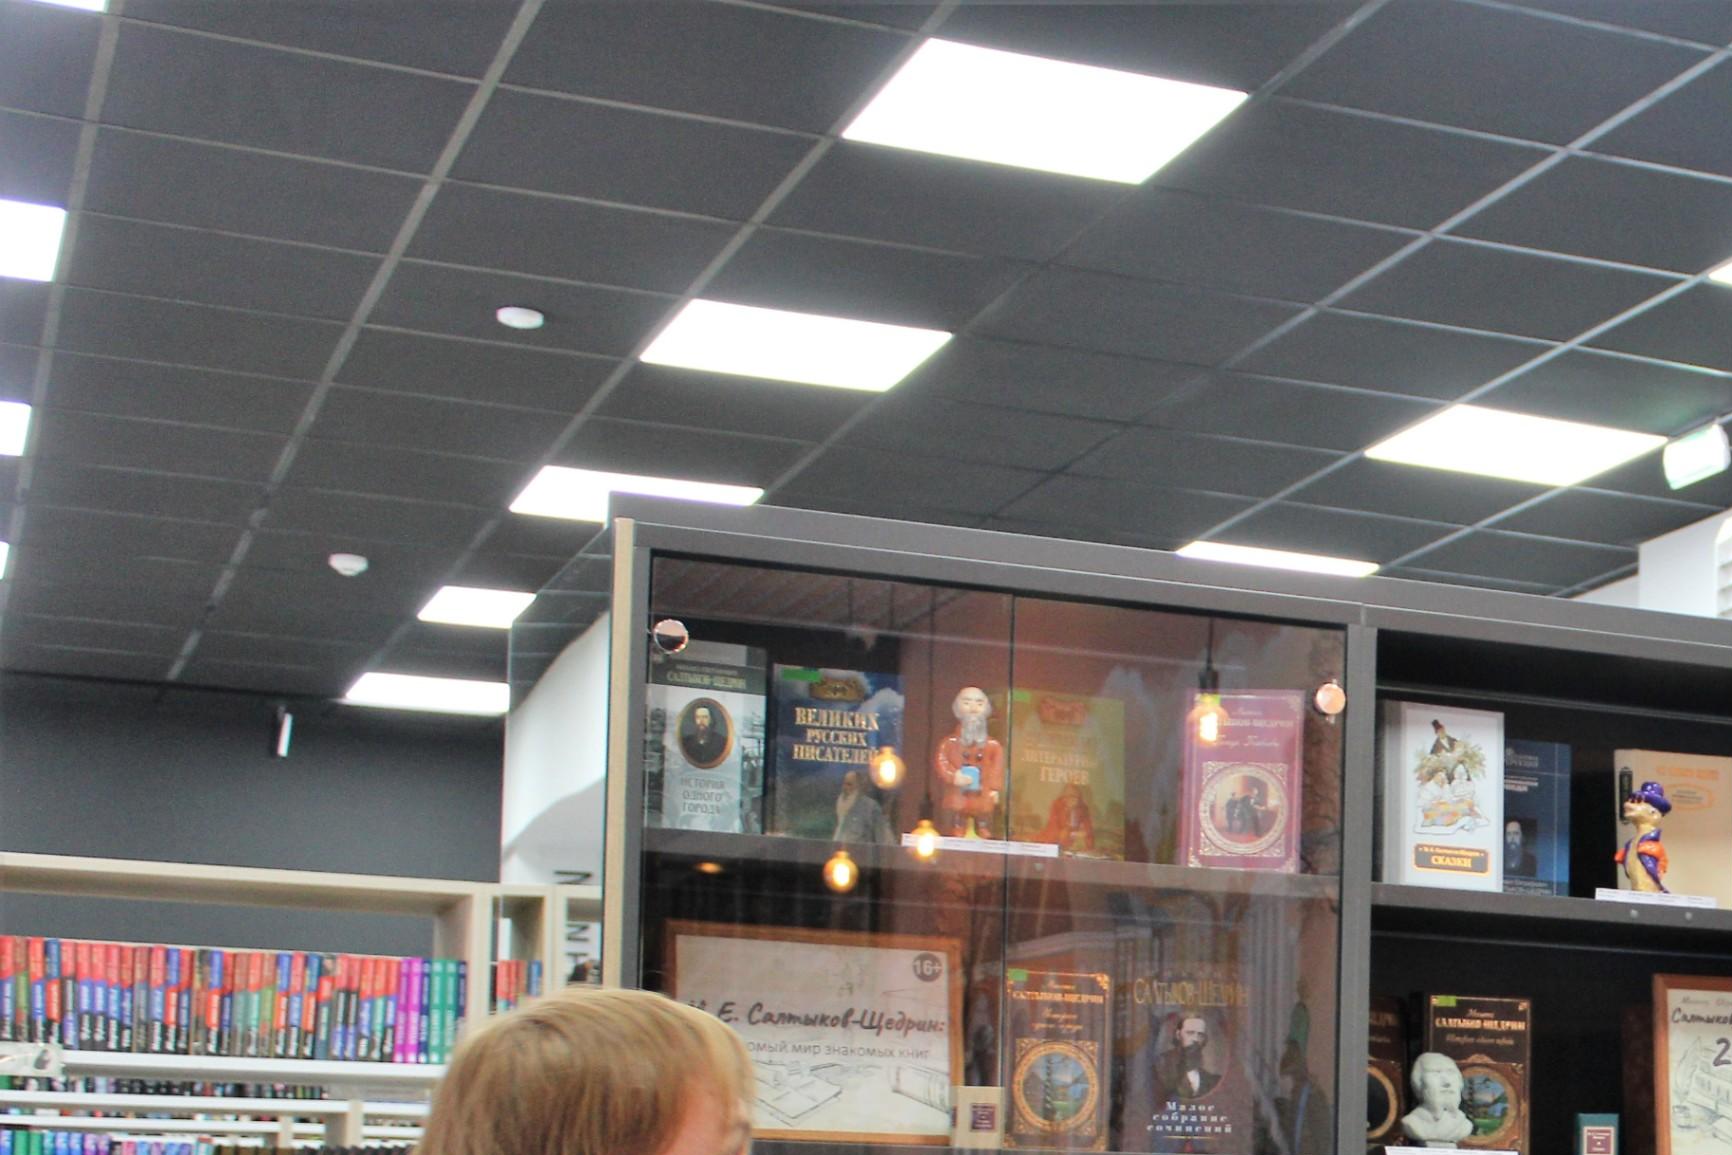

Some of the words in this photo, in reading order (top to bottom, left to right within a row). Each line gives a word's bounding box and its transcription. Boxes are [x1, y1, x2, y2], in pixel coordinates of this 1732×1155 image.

[795, 706, 880, 731] ВЕЛИКИХ
[805, 728, 867, 747] РУССКИХ
[1431, 854, 1472, 869] СКАЗКИ
[914, 959, 942, 975] 16+
[748, 1002, 945, 1037] Салтыков-Щедрин:
[825, 1046, 894, 1058] знакомых
[1165, 1101, 1216, 1112] Малое
[1152, 1112, 1228, 1123] собрание
[1146, 1122, 1233, 1134] сочинений
